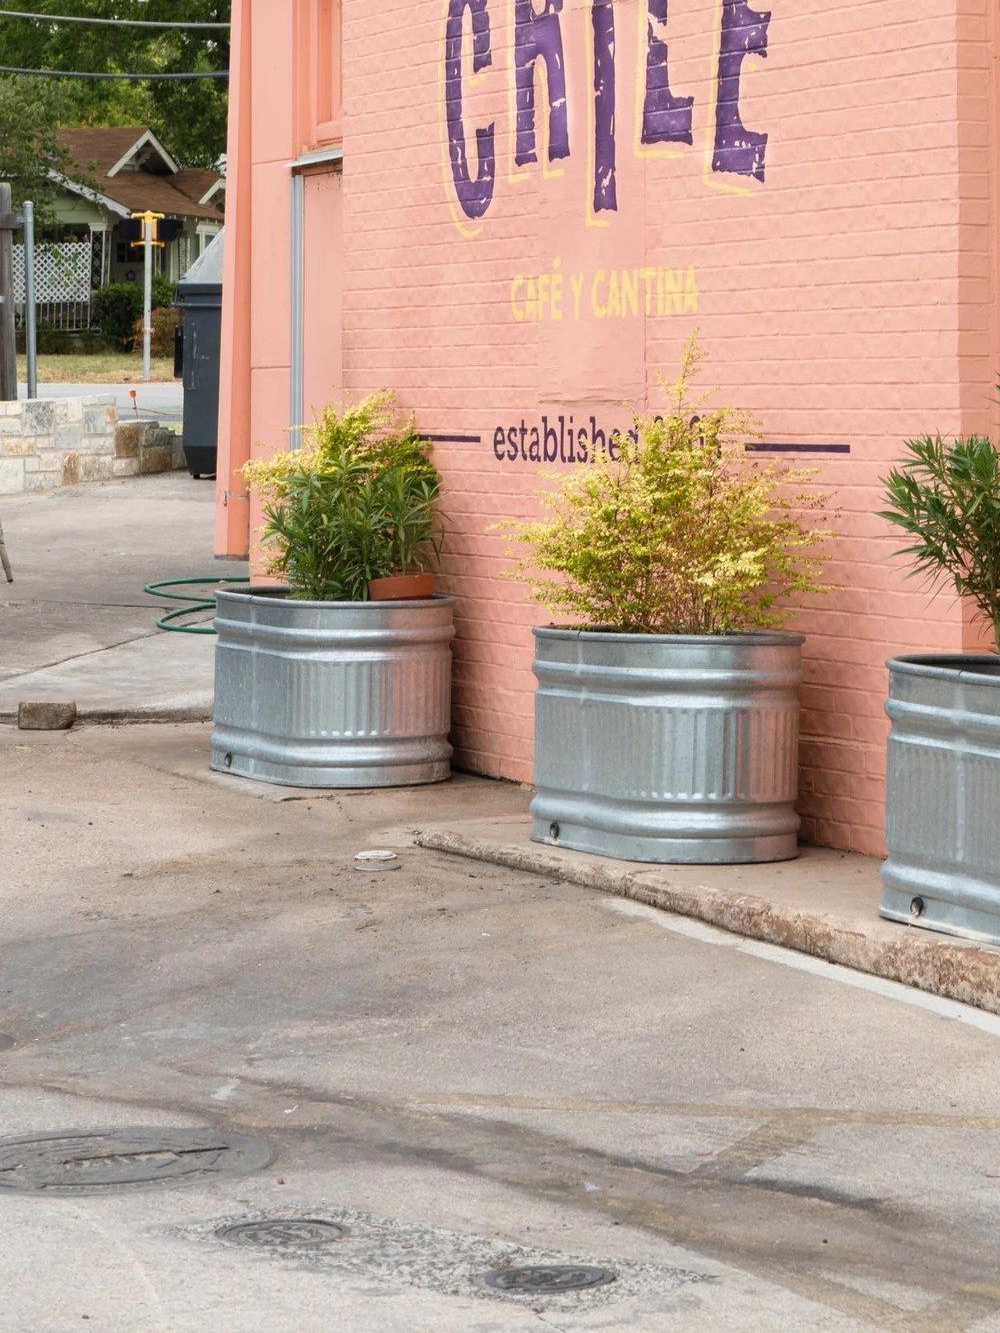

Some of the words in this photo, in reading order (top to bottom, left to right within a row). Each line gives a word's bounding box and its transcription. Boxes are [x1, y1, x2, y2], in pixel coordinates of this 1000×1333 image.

[510, 256, 563, 322] CAFÉ
[569, 269, 585, 321] Y
[591, 265, 699, 319] CANTINA
